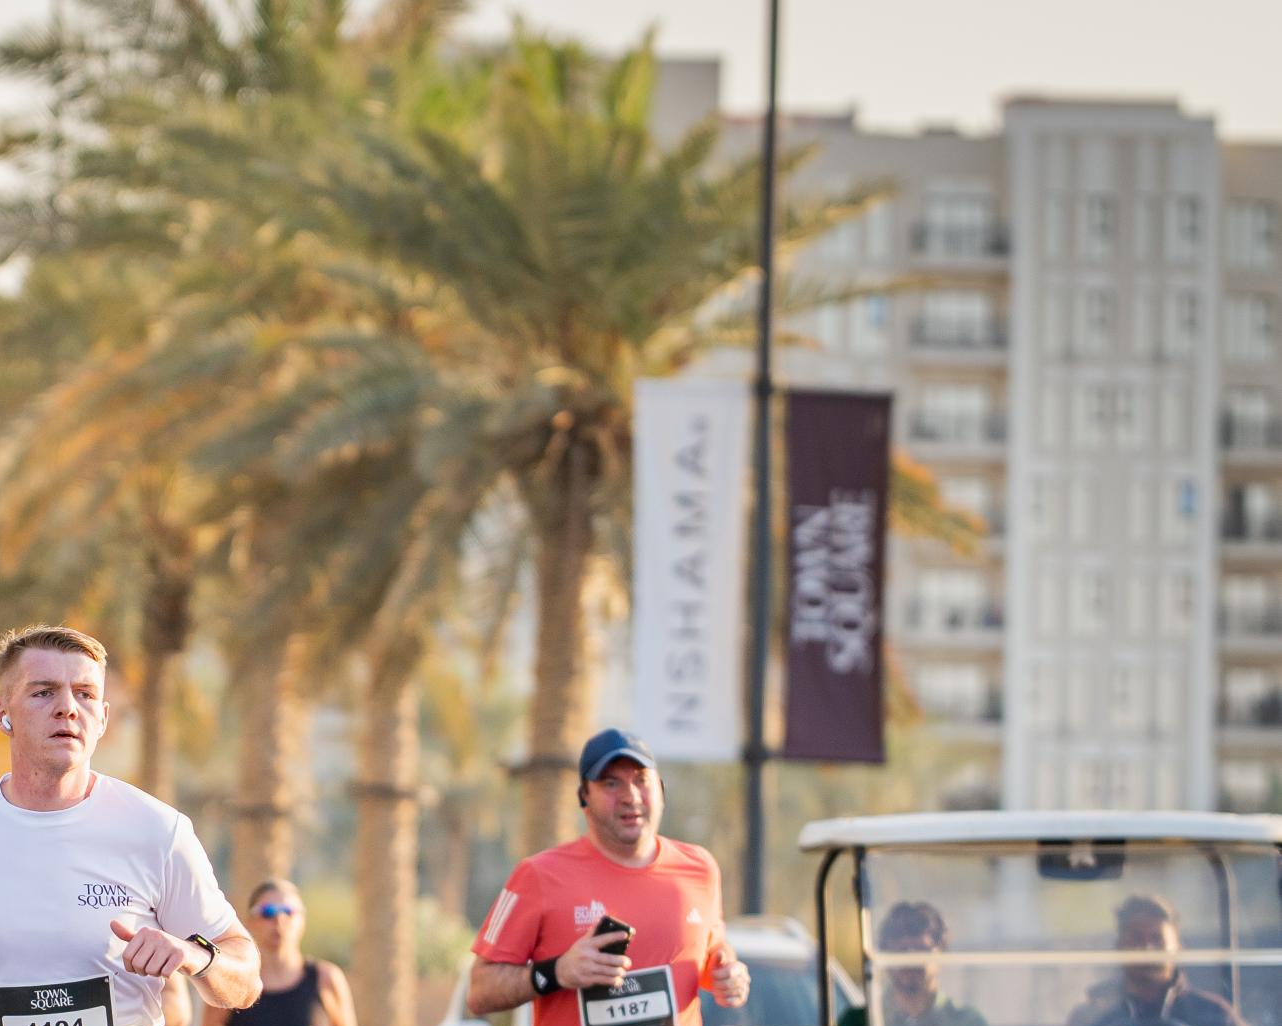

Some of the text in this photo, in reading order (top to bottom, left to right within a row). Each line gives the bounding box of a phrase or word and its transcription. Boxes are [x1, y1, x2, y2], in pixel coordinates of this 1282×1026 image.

[792, 505, 829, 644] TOWN
[828, 488, 876, 673] SQUARE
[83, 883, 127, 896] TOWN
[77, 895, 134, 909] SQUARE
[33, 988, 69, 999] TOWN
[30, 996, 75, 1010] SQUARE
[606, 1000, 648, 1018] 1187
